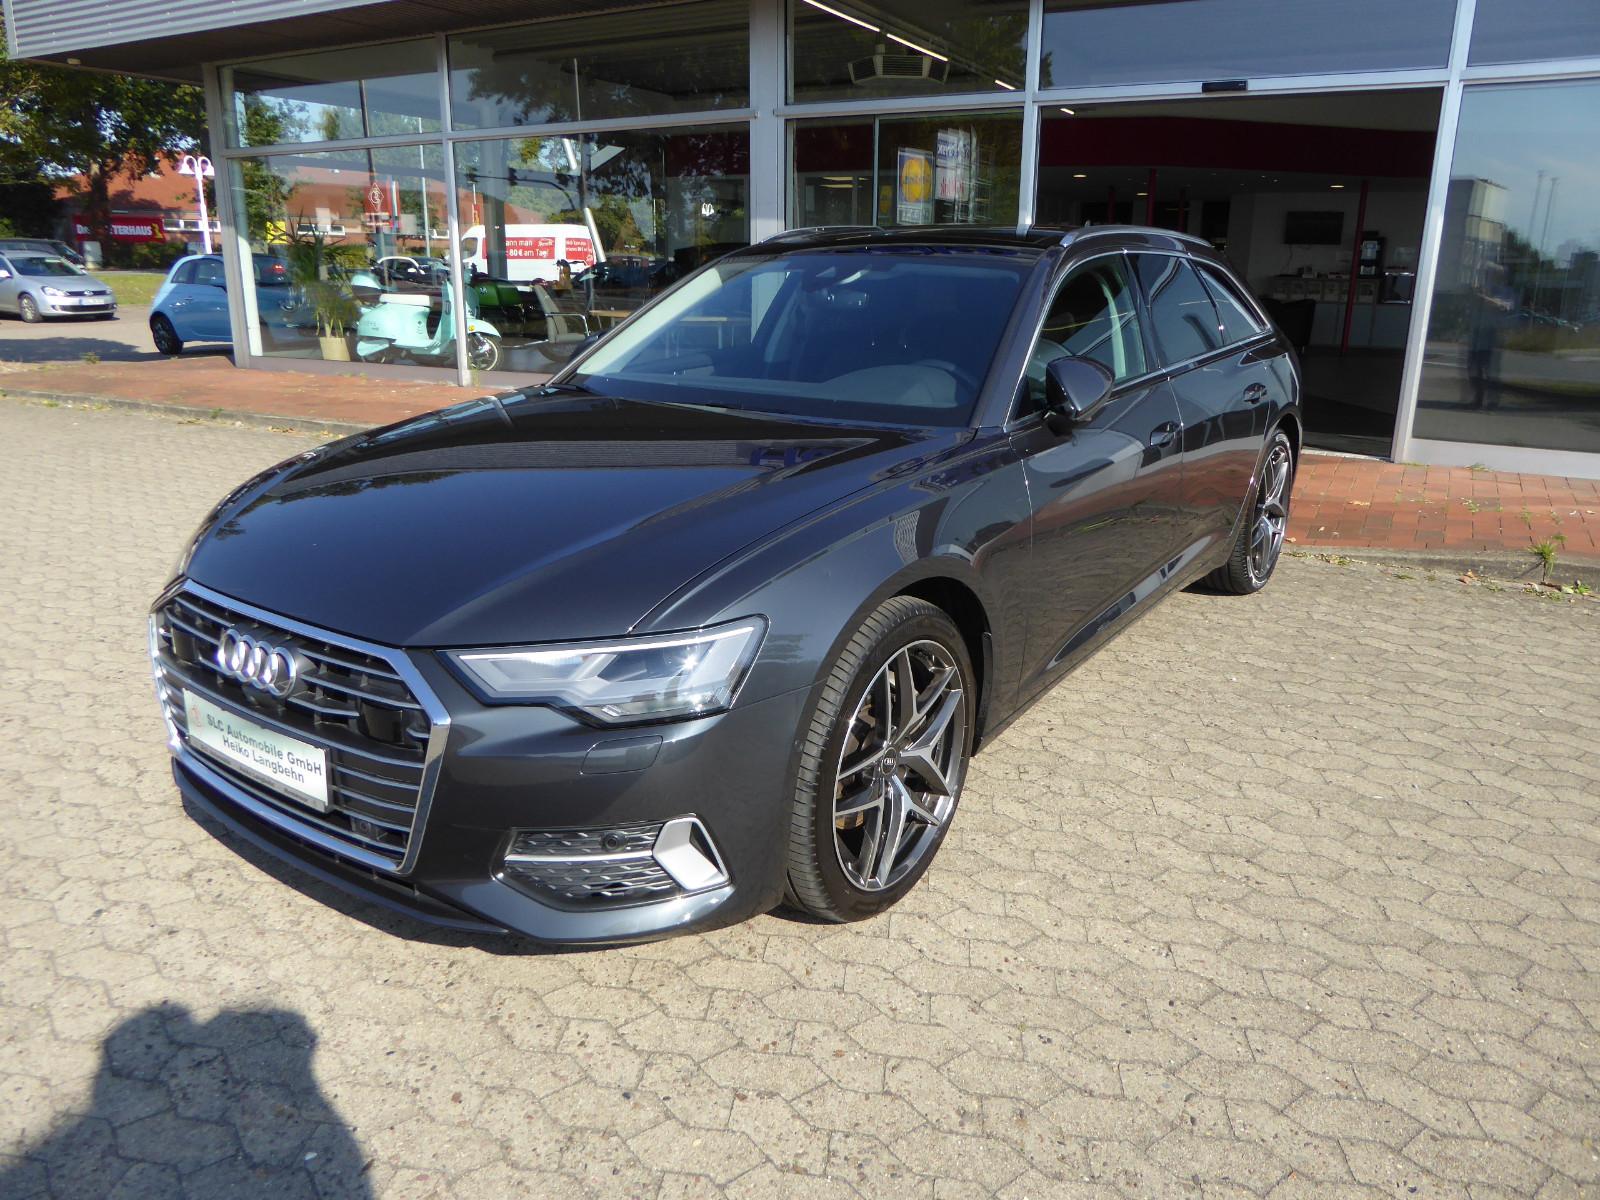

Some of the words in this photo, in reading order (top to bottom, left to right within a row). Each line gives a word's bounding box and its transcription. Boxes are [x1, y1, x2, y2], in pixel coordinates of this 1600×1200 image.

[101, 224, 153, 236] TERHAUS
[207, 713, 225, 732] SLC
[227, 725, 284, 760] Automobile
[287, 752, 322, 777] GmbH
[222, 734, 250, 758] Heiko
[252, 753, 305, 784] Langbehn
